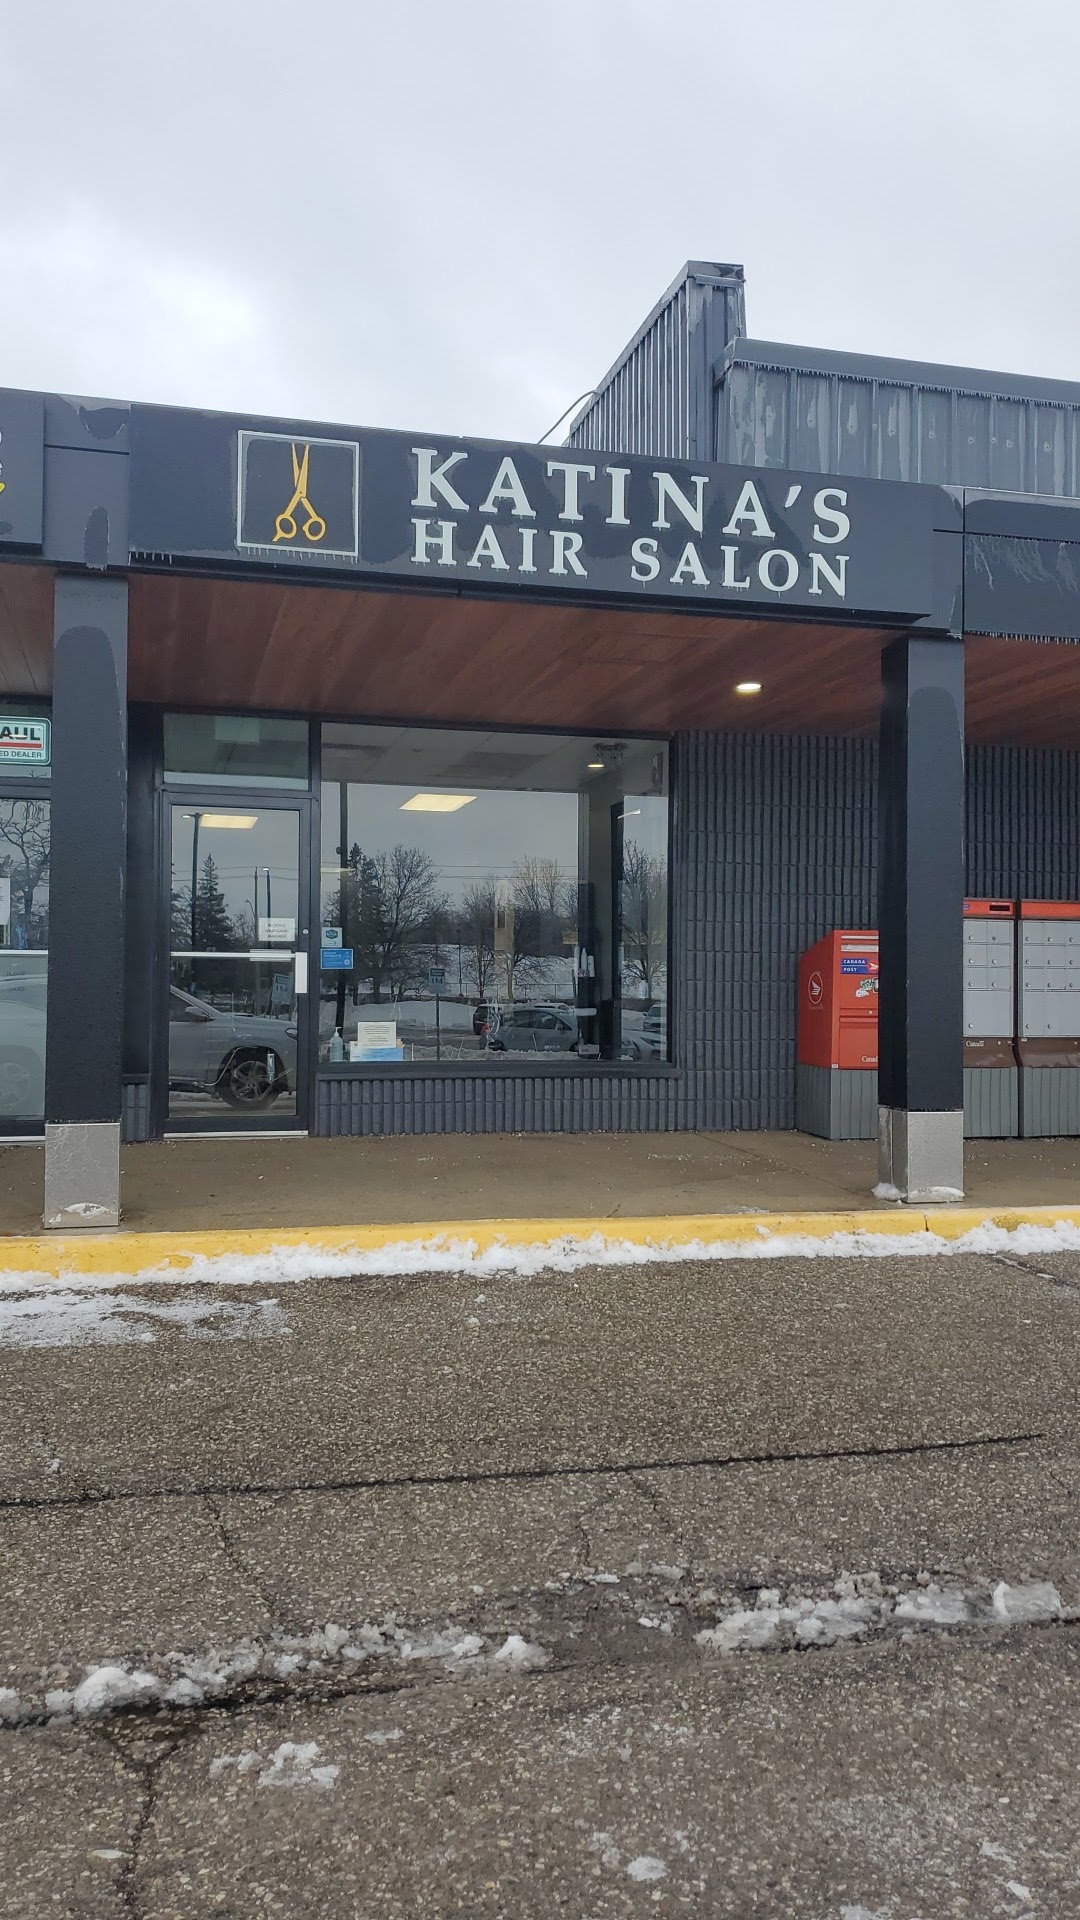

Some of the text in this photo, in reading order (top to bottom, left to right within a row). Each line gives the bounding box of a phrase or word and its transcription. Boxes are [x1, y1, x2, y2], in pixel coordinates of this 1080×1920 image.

[411, 447, 851, 544] KATINA'S
[410, 518, 850, 597] HAIR SALON
[11, 750, 42, 758] DEALER
